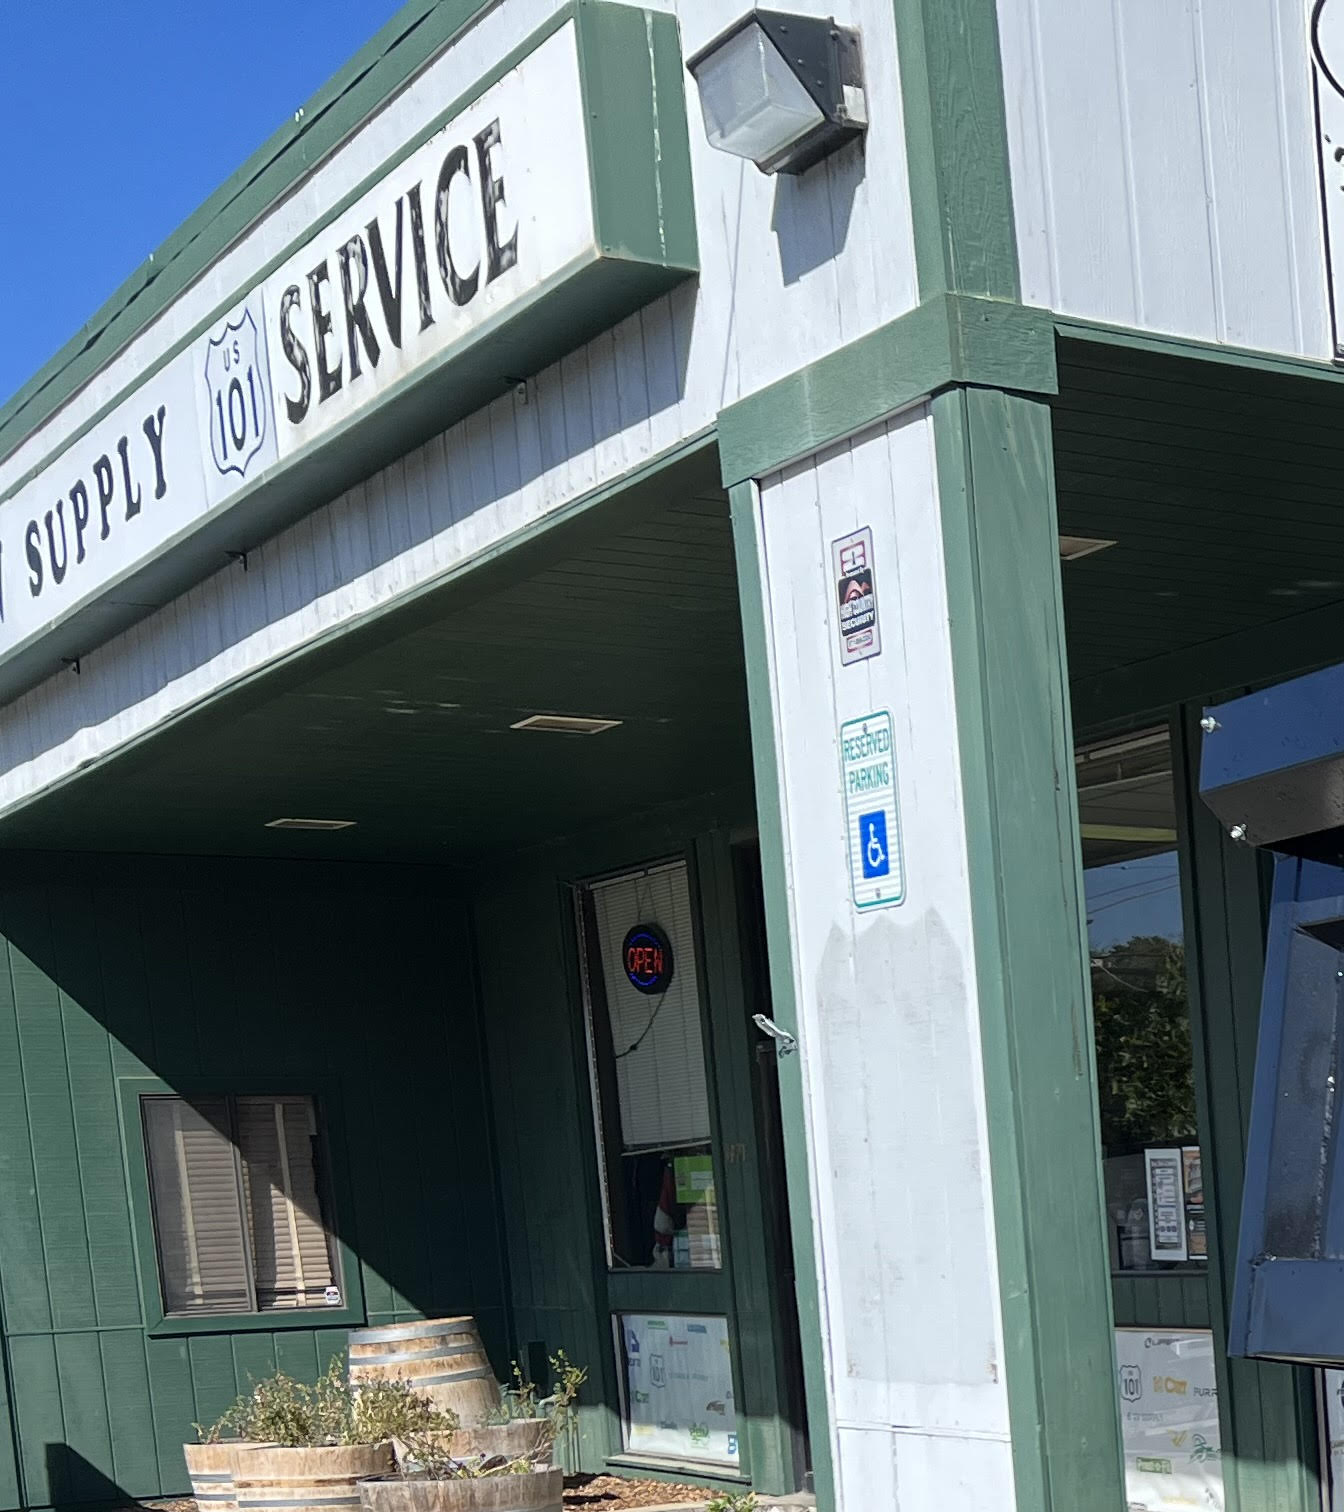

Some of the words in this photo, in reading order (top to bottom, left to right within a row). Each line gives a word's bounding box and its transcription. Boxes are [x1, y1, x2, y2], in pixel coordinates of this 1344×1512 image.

[280, 117, 518, 425] SERVICE
[223, 340, 242, 370] US
[215, 364, 261, 460] 101
[25, 404, 167, 598] SUPPLY
[843, 728, 890, 762] RESERVED
[848, 761, 890, 794] PARKING
[628, 947, 664, 975] OPEN
[1124, 1378, 1139, 1396] 101
